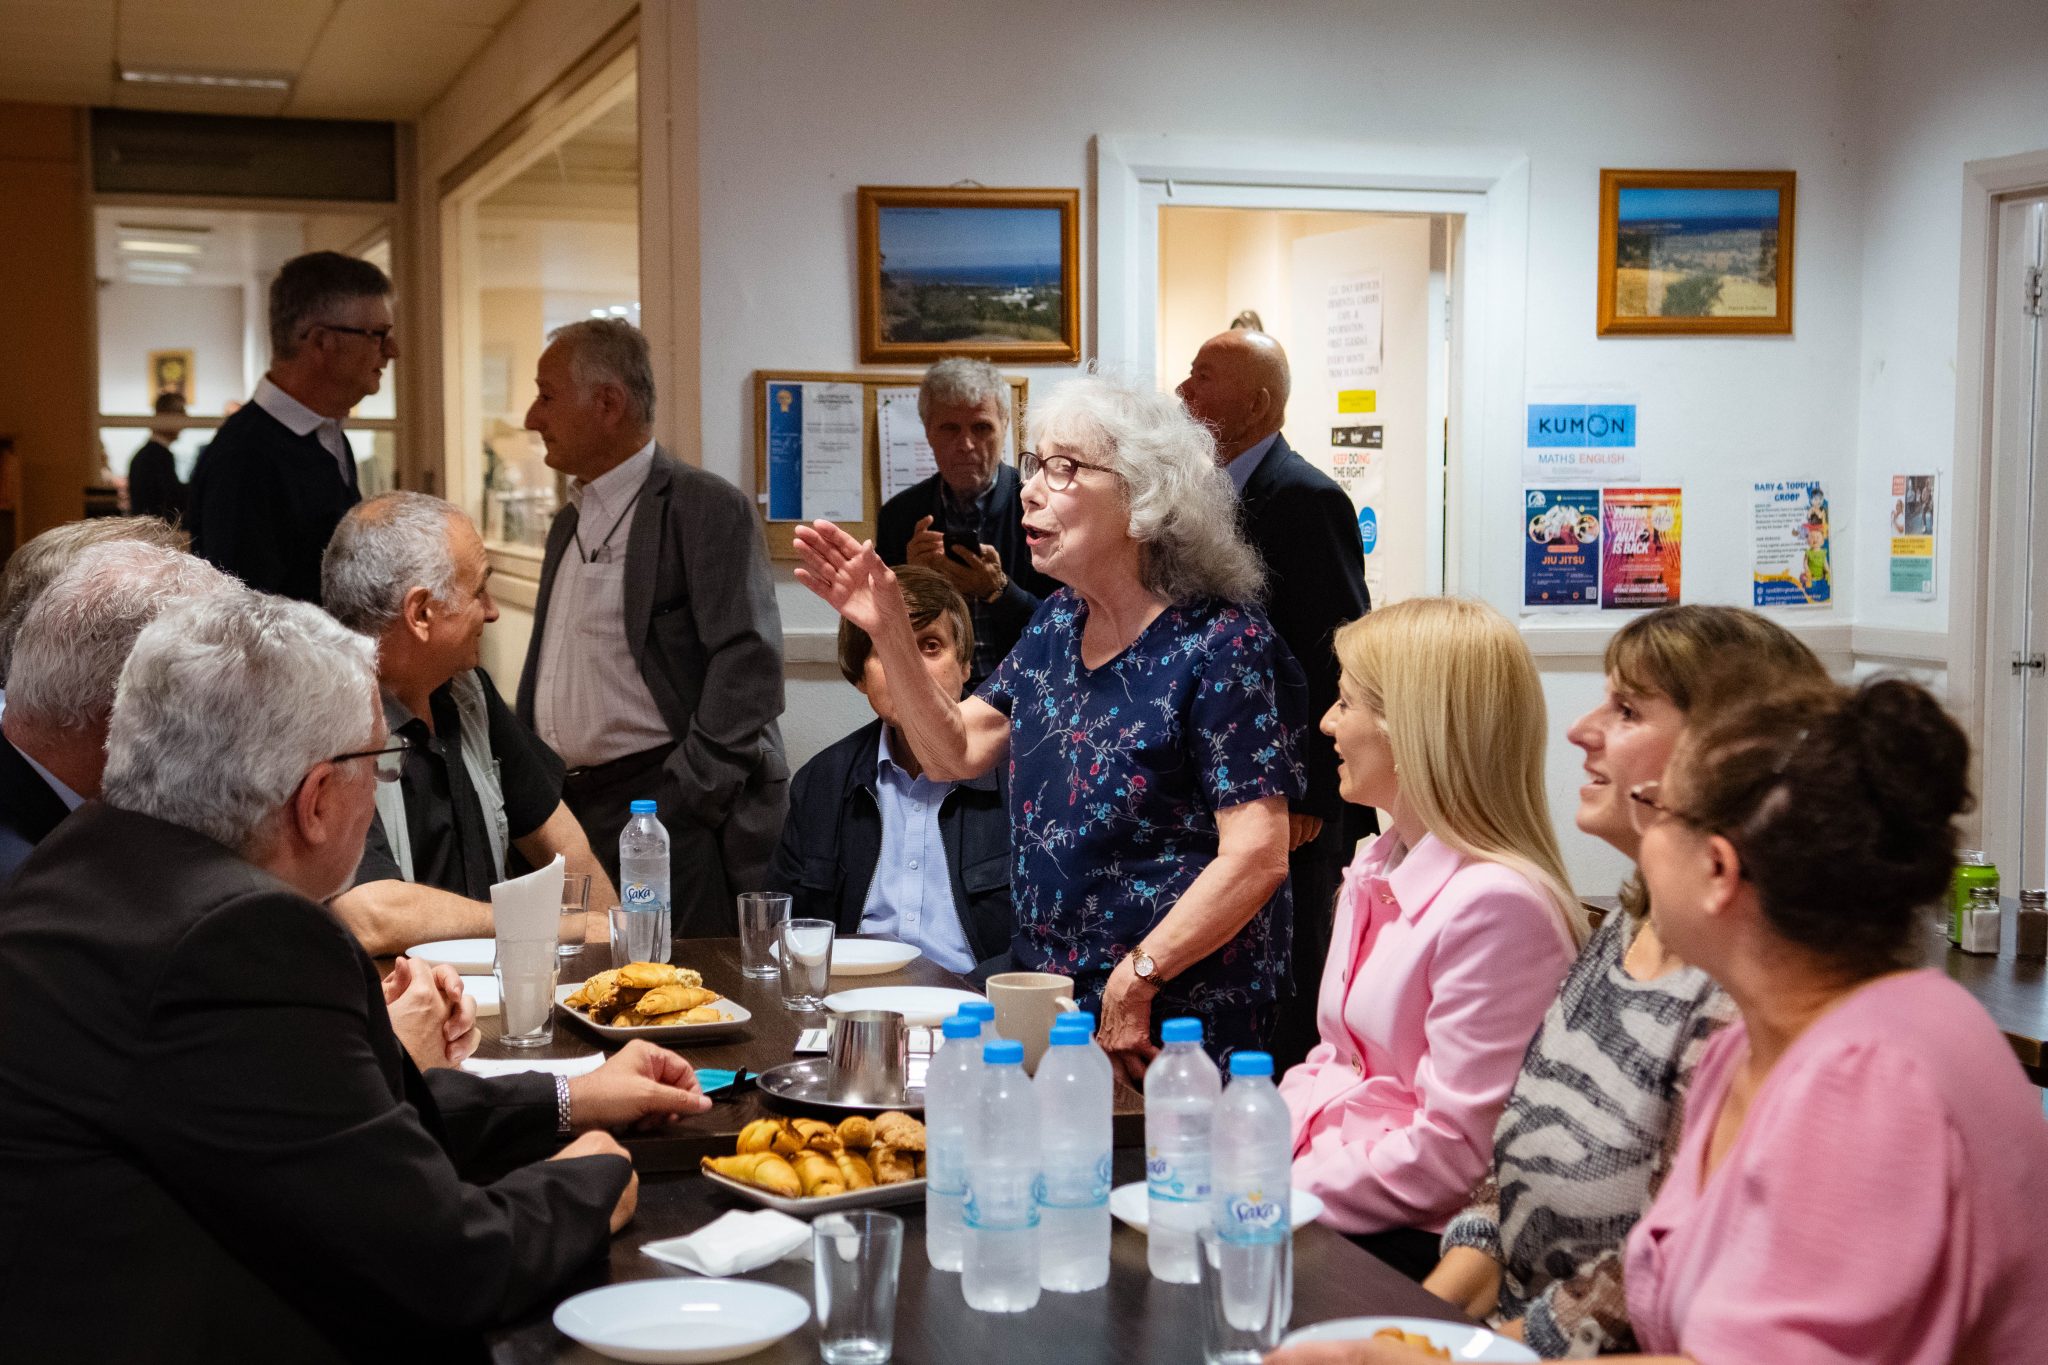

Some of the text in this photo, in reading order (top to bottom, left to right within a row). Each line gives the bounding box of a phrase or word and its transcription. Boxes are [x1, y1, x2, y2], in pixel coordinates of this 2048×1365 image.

[1539, 414, 1624, 437] KUMON
[1349, 453, 1371, 464] DOING
[1539, 453, 1624, 464] MATHS ENGLISH
[1333, 467, 1364, 478] THE RIGHT
[1754, 483, 1775, 491] BABY
[1612, 542, 1650, 554] IS BACK
[1542, 556, 1585, 565] JIU JITSU
